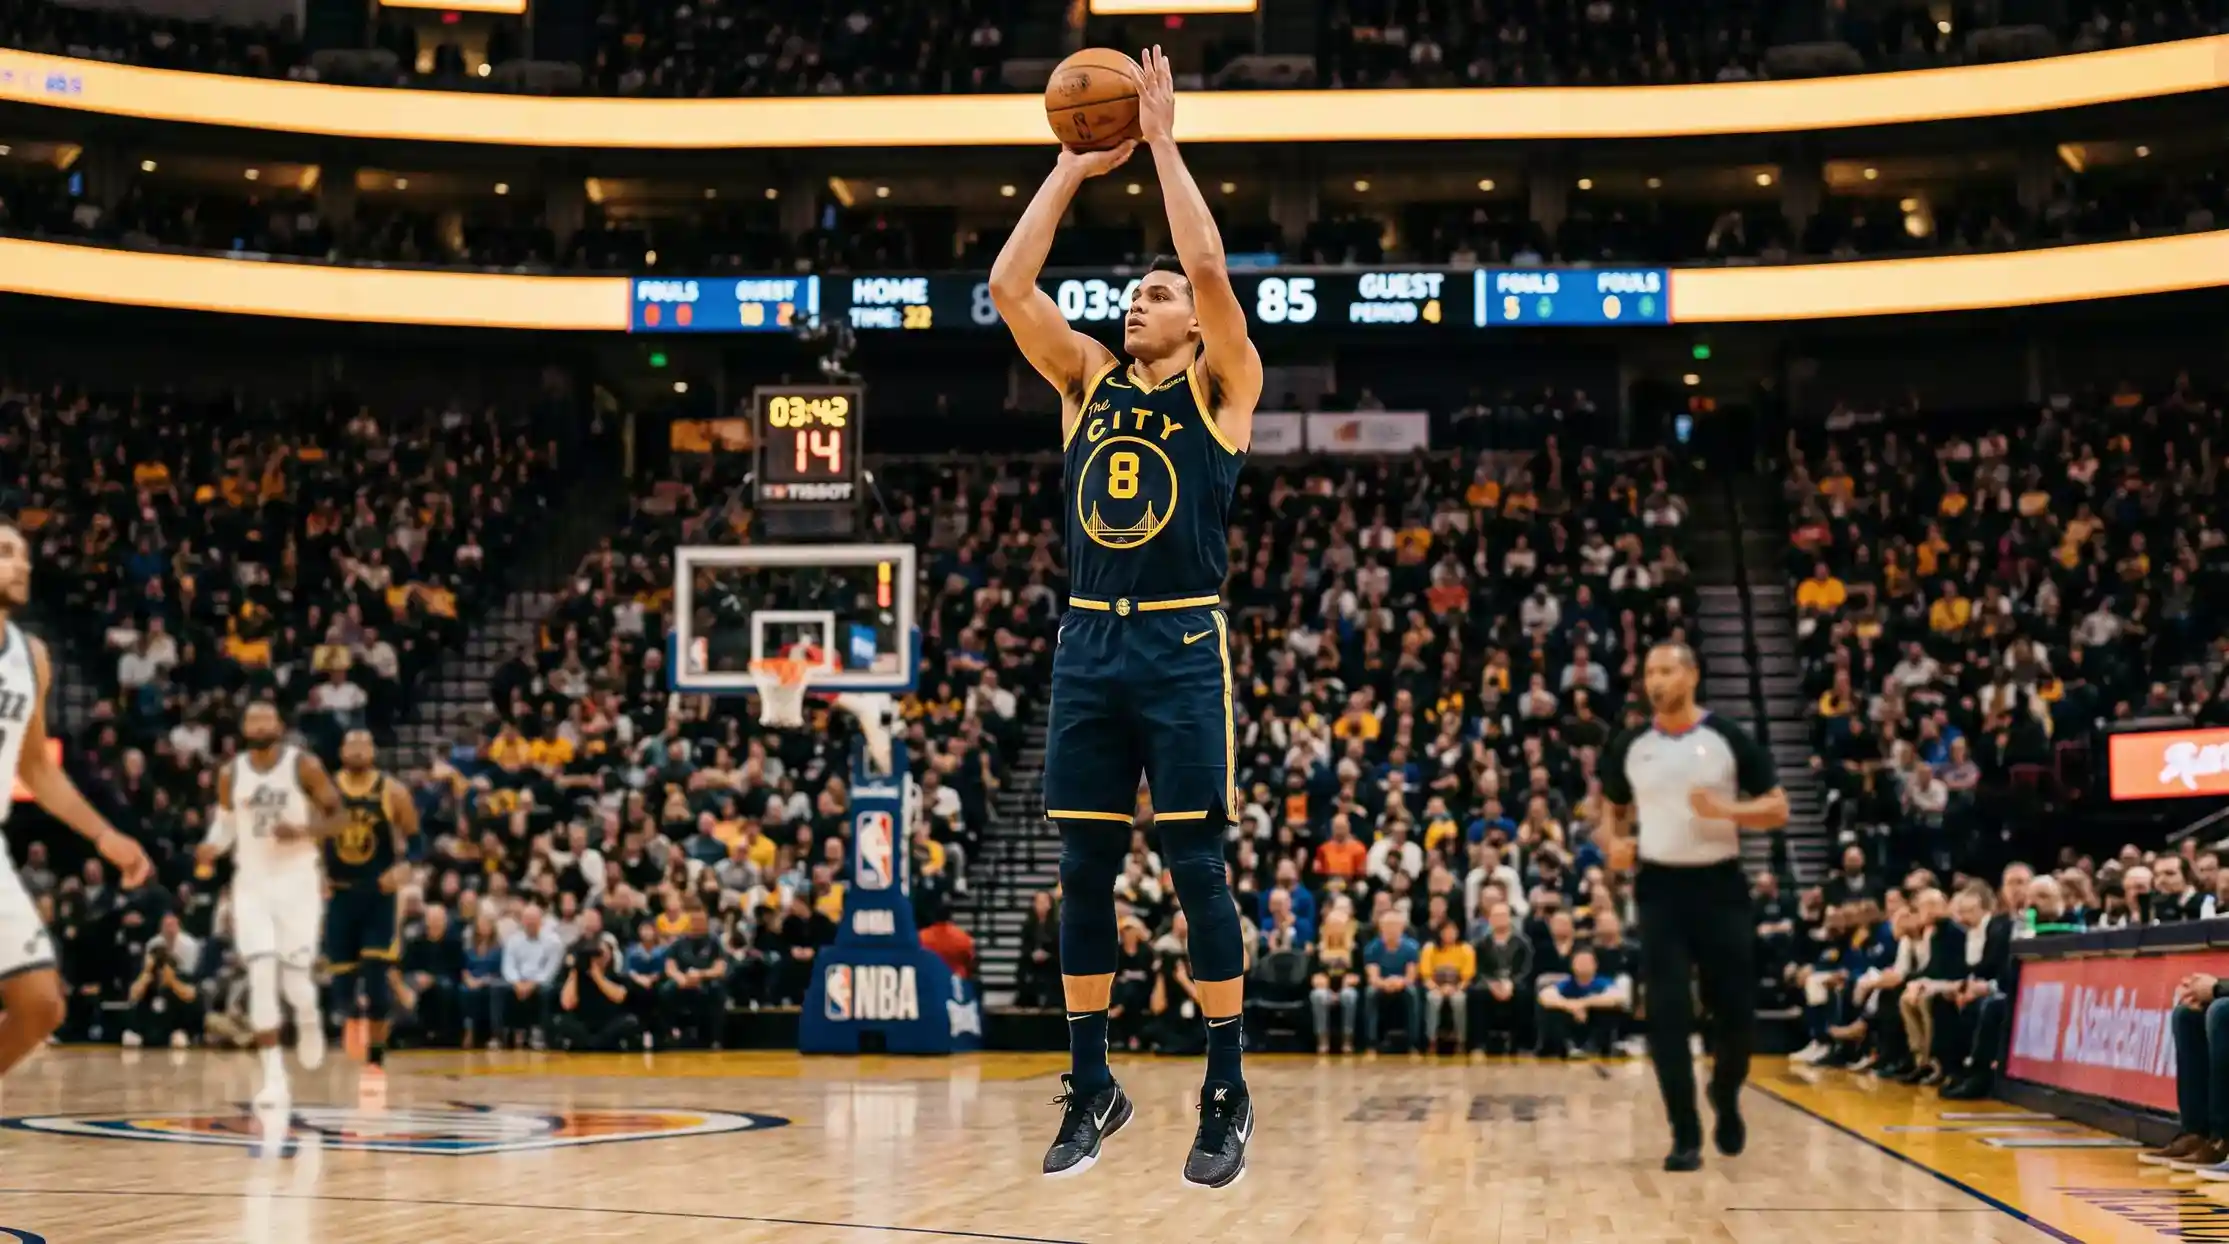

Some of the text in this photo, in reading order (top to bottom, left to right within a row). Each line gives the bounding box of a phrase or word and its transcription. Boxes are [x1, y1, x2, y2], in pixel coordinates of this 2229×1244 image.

[852, 277, 929, 304] HOME
[1257, 277, 1317, 323] 85
[1359, 273, 1444, 299] GUEST
[769, 396, 848, 427] 03:42
[1087, 407, 1184, 442] CITY
[796, 430, 841, 473] 14
[1108, 451, 1140, 499] 8
[854, 965, 919, 1020] NBA
